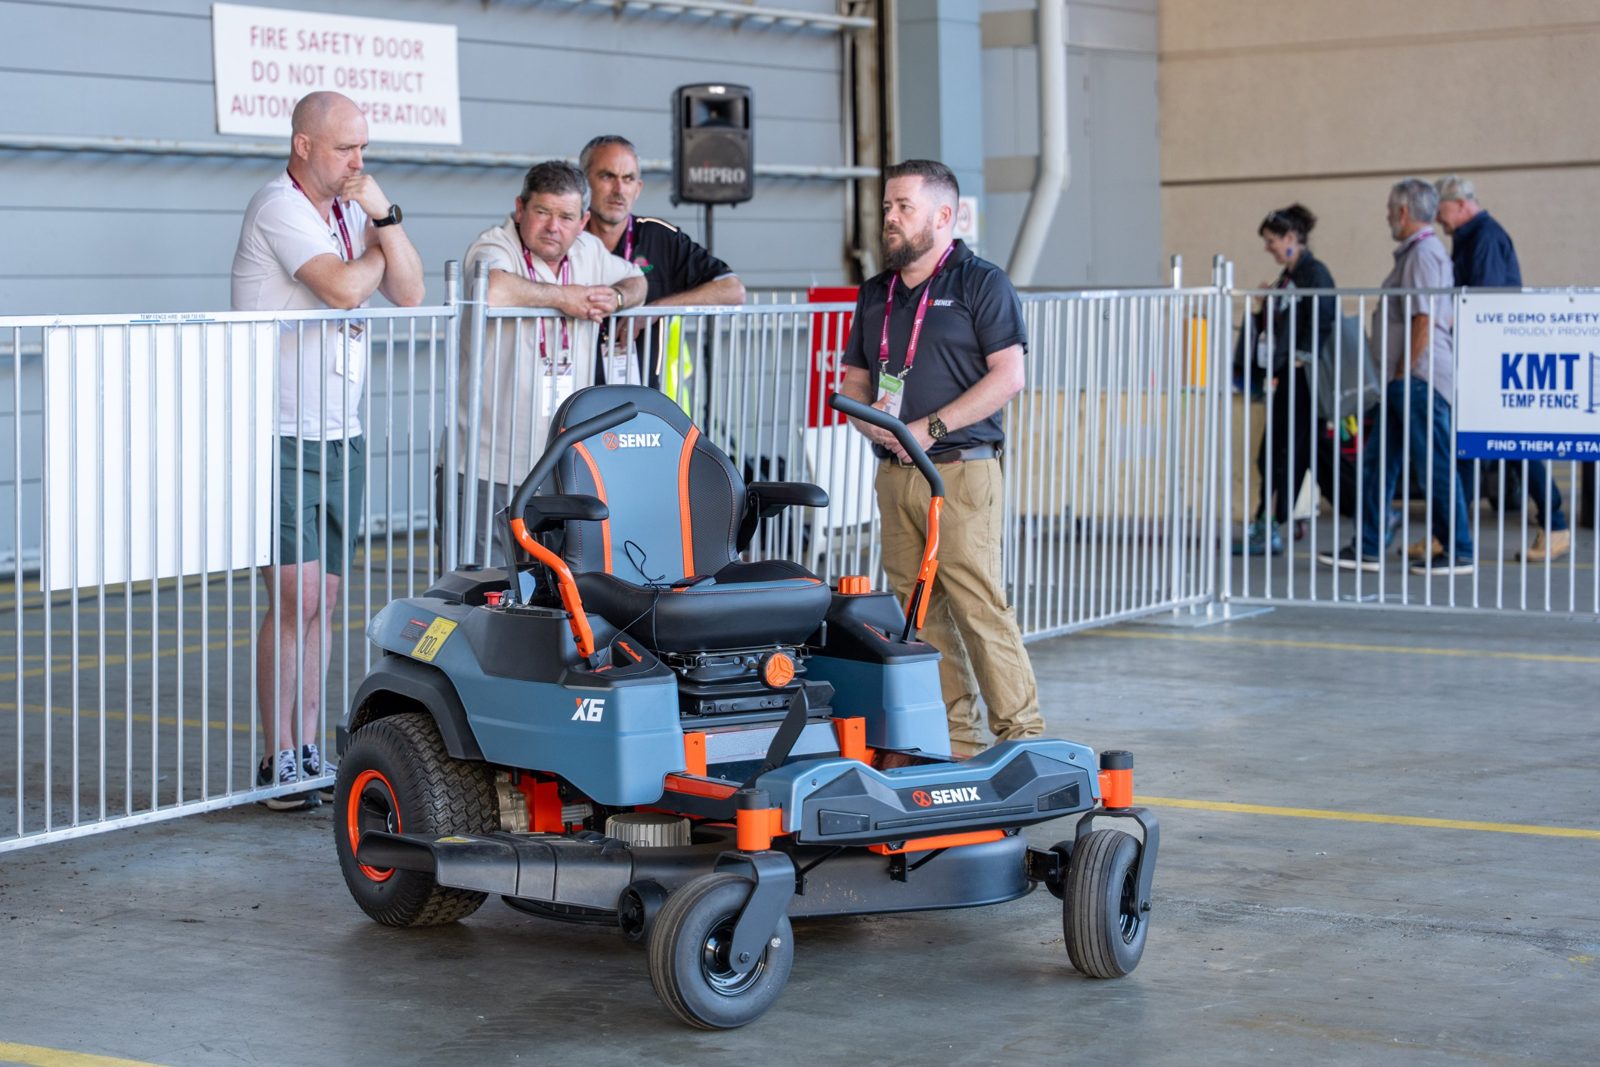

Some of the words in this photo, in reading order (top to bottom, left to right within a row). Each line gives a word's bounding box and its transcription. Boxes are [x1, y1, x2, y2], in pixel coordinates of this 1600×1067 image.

[250, 25, 288, 50] FIRE
[297, 29, 366, 55] SAFETY
[372, 36, 424, 60] DOOR
[251, 60, 280, 83] DO
[288, 64, 325, 86] NOT
[333, 67, 424, 93] OBSTRUCT
[230, 94, 299, 118] AUTOM
[360, 103, 447, 127] PERATION
[1476, 313, 1503, 323] LIVE
[1508, 313, 1546, 323] DEMO
[1550, 312, 1599, 323] SAFETY
[1503, 326, 1554, 337] PROUDLY
[1501, 353, 1580, 390] KMT
[1501, 393, 1535, 408] TEMP
[1540, 394, 1579, 409] FENCE
[619, 433, 661, 448] SENIX
[1486, 440, 1517, 450] FIND
[1519, 440, 1553, 451] THEM
[1556, 441, 1573, 452] AT
[571, 697, 605, 722] X6
[930, 786, 981, 805] SENIX
